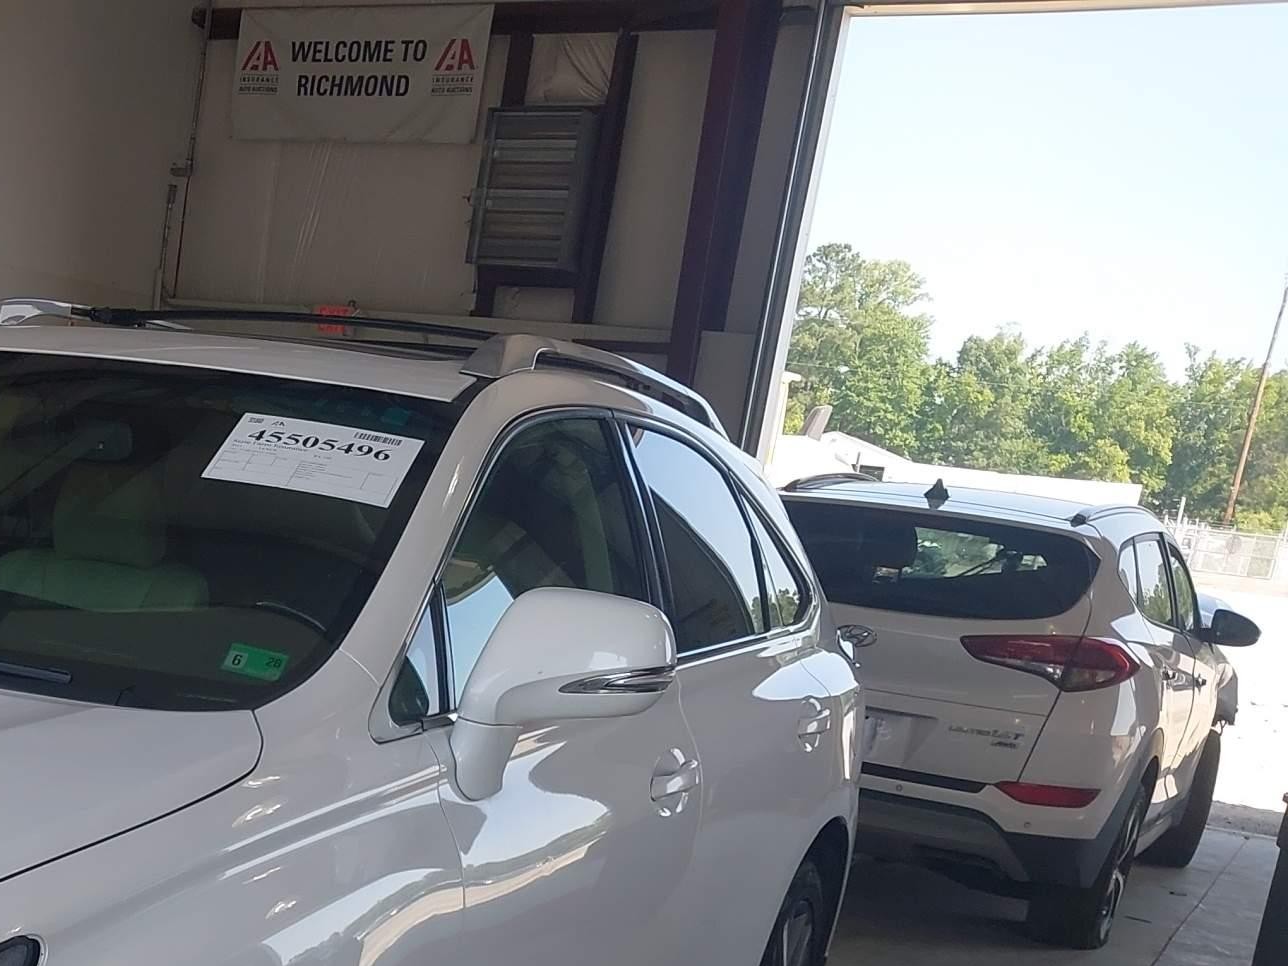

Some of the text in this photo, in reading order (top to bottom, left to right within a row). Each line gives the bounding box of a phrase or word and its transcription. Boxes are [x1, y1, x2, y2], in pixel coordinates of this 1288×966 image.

[291, 39, 428, 64] WELCOME TO
[297, 75, 410, 98] RICHMOND
[248, 429, 392, 461] 45505496
[232, 654, 243, 666] 6
